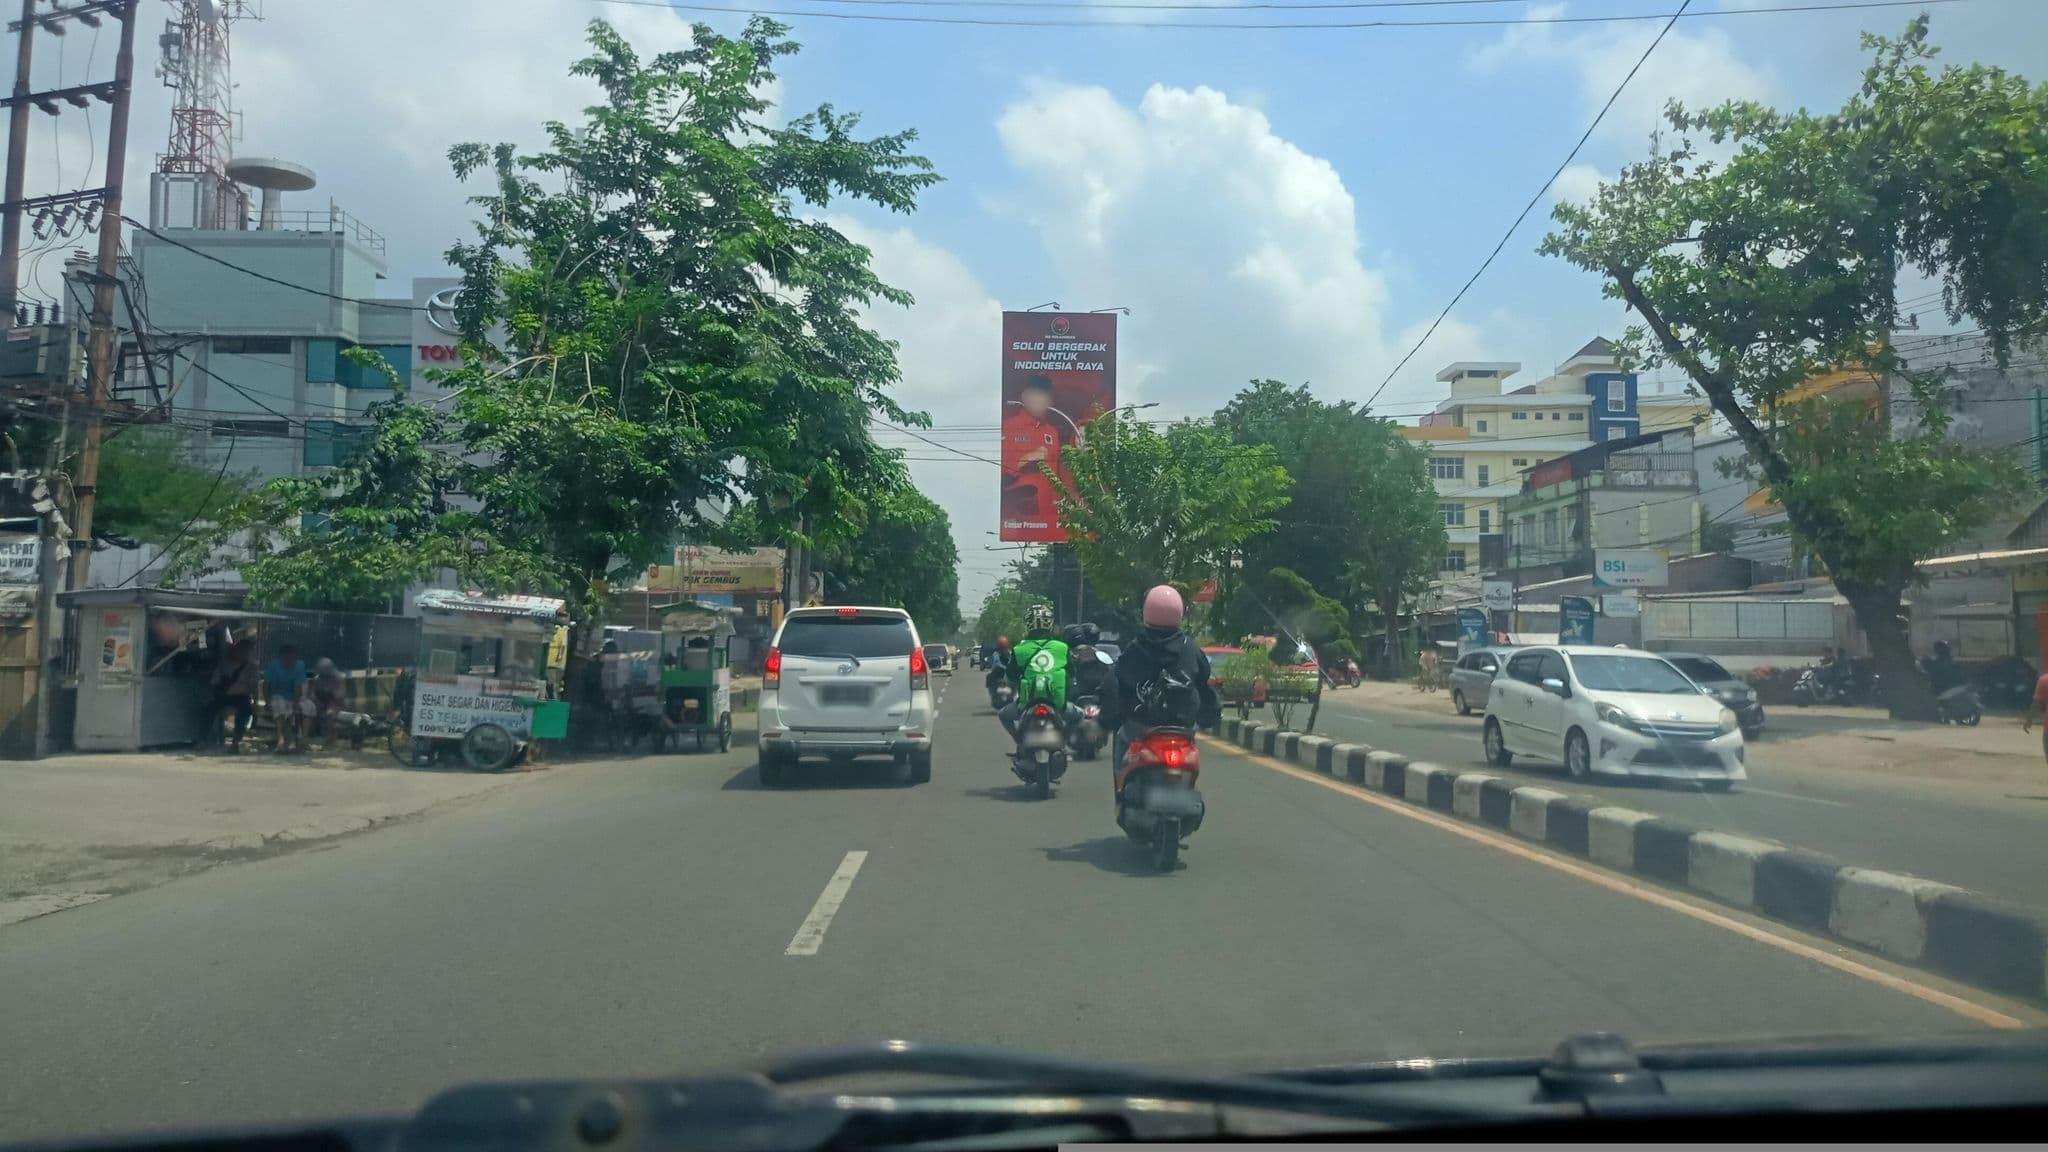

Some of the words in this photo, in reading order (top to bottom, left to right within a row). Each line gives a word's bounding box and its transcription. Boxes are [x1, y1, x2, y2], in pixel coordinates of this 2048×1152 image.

[1012, 342, 1044, 351] SOLID
[1048, 343, 1107, 352] BERGERAK
[1041, 352, 1078, 361] UNTUK
[1014, 361, 1073, 370] INDONESIA
[1076, 362, 1104, 371] RAYA
[1603, 560, 1625, 572] BSI
[703, 576, 741, 584] GEMBUS
[422, 694, 445, 706] SEHAT
[448, 696, 472, 709] SEGAR
[475, 697, 490, 710] DAN
[420, 709, 434, 720] ES
[437, 712, 467, 724] TEBU
